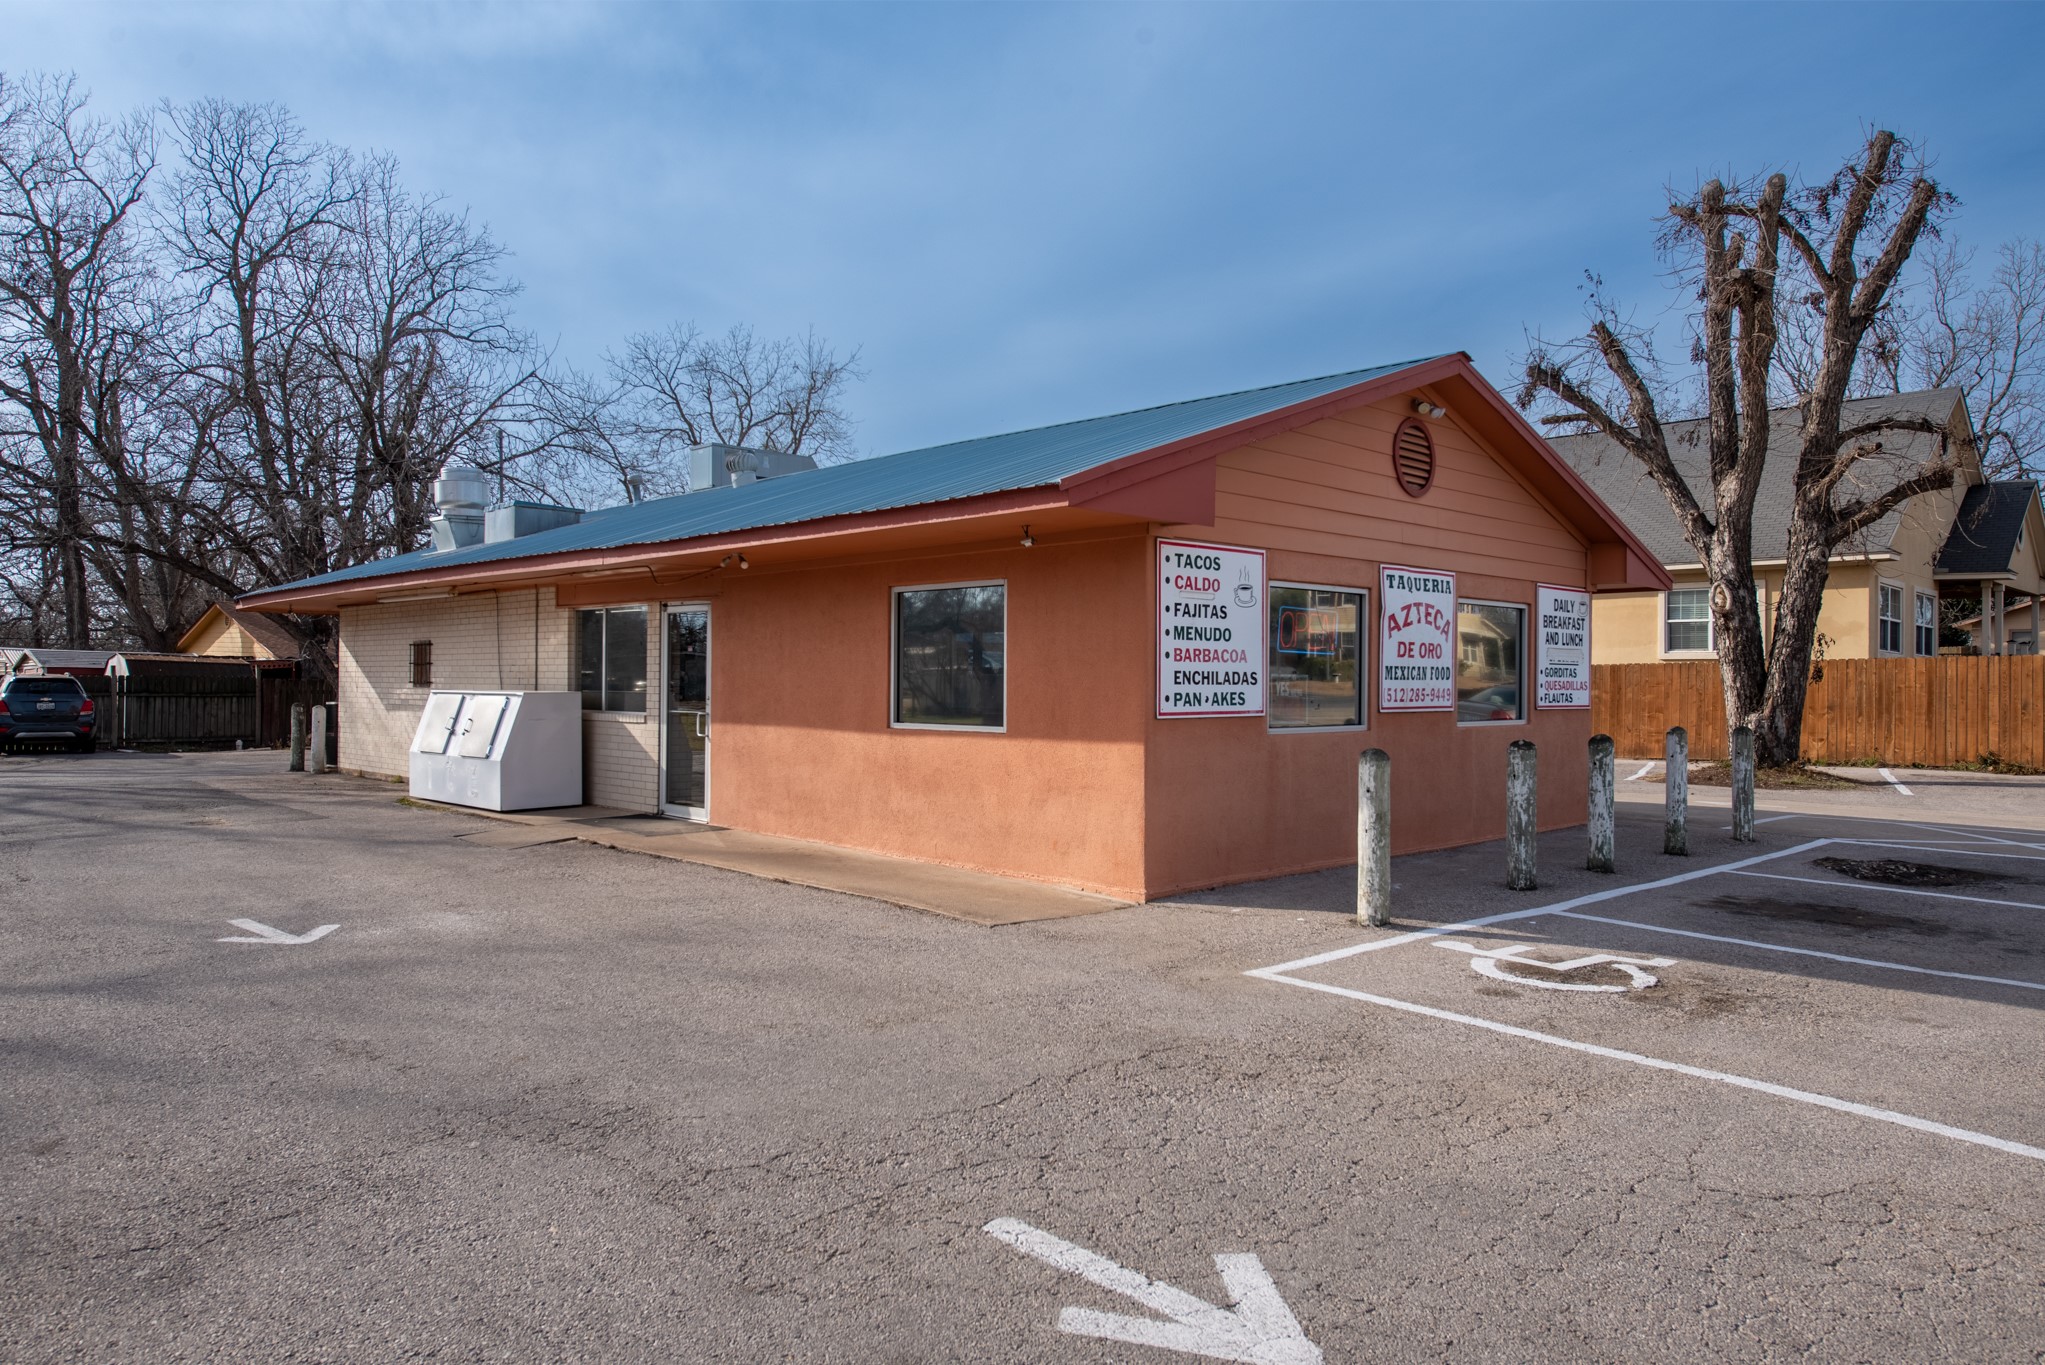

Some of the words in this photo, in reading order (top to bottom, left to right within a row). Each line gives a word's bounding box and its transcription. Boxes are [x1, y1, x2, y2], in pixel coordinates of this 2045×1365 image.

[1174, 553, 1221, 571] TACOS
[1174, 575, 1221, 592] CALDO
[1386, 574, 1452, 594] TAQUERIA
[1174, 602, 1228, 619] FAJITAS
[1553, 598, 1575, 613] DAILY
[1387, 602, 1451, 643] AZTECA
[1543, 615, 1585, 631] BREAKFAST
[1173, 625, 1232, 642] MENUDO
[1280, 611, 1336, 651] OPEN
[1545, 631, 1559, 646] AND
[1561, 632, 1583, 647] LUNCH
[1173, 648, 1248, 663] BARBACOA
[1397, 641, 1415, 659] DE
[1418, 642, 1442, 660] ORO
[1174, 670, 1258, 686] ENCHILADAS
[1384, 665, 1427, 681] MEXICAN
[1429, 666, 1451, 681] FOOD
[1544, 667, 1578, 679] GORDITAS
[1544, 680, 1588, 692] QUESADILLAS
[1173, 691, 1246, 707] PANAKES
[1544, 693, 1573, 704] FLAUTAS
